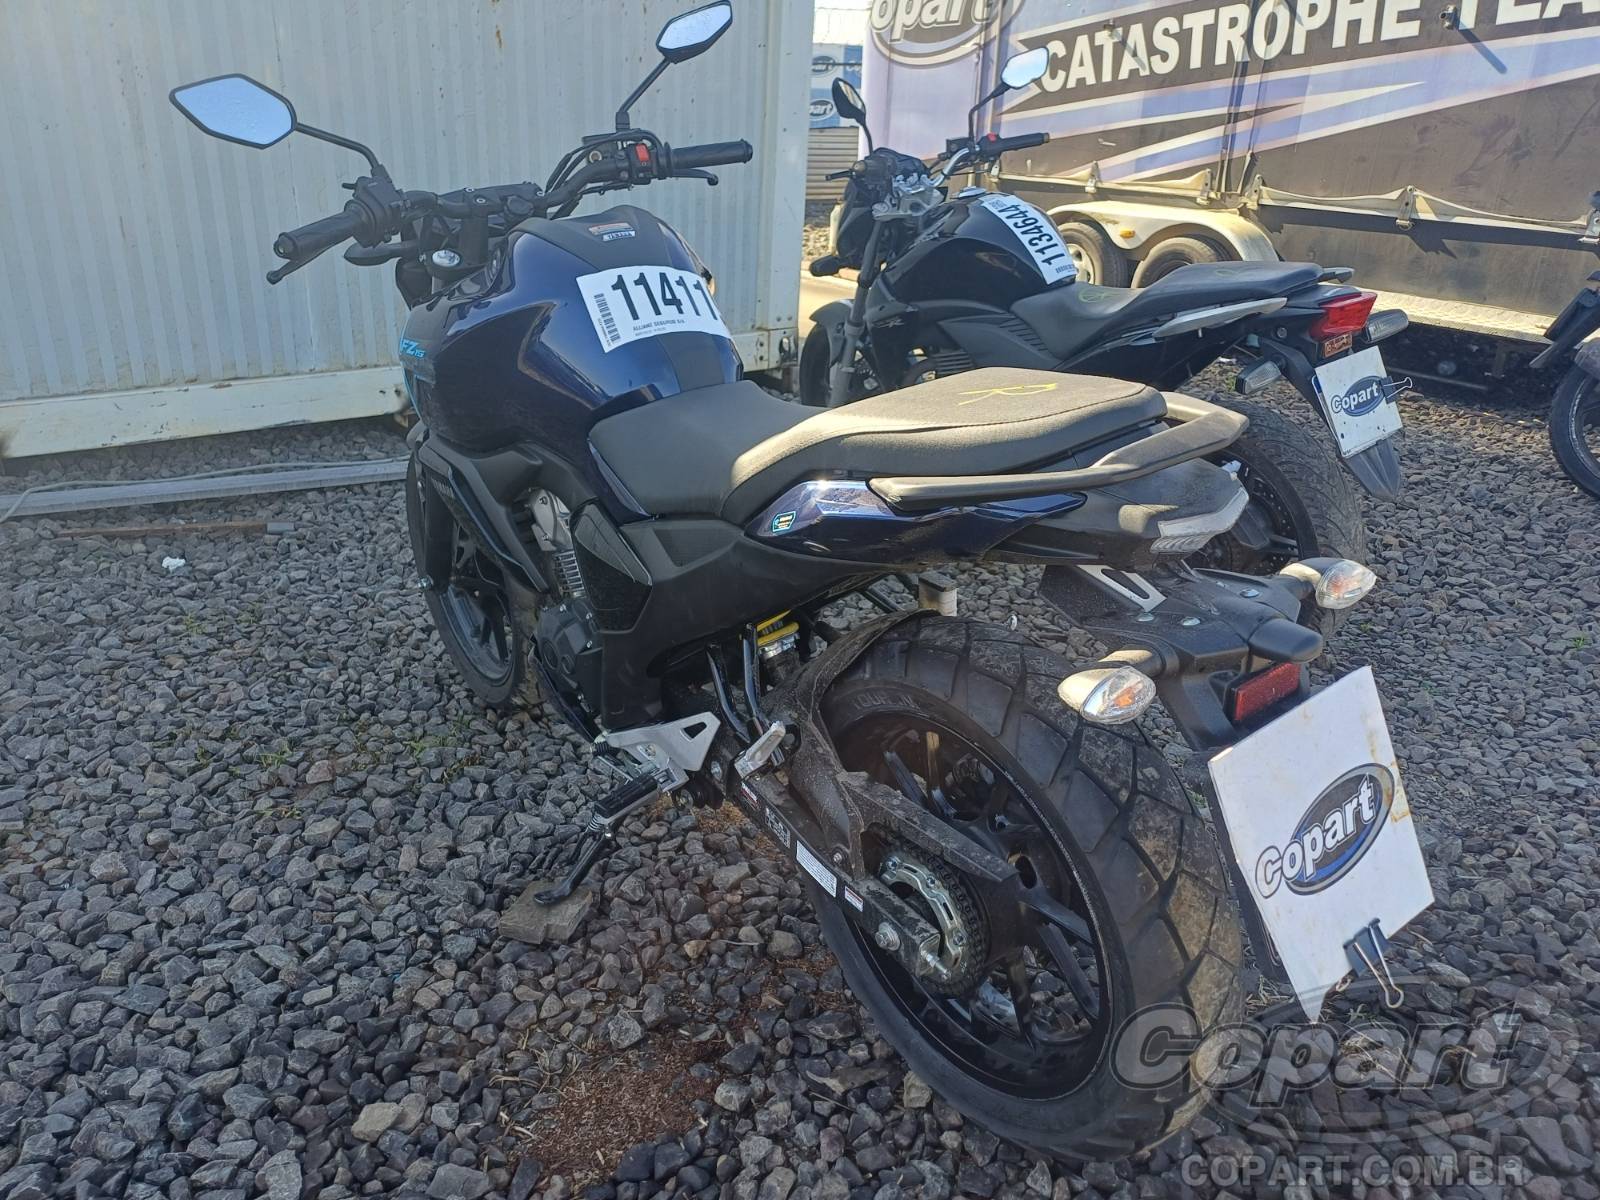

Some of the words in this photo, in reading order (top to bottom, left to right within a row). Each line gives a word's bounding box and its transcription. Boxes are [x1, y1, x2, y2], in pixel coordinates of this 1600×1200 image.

[1041, 0, 1422, 93] CATASTROPHE
[998, 204, 1066, 266] 1134644
[1331, 382, 1379, 413] Copart
[1255, 772, 1375, 899] Copart
